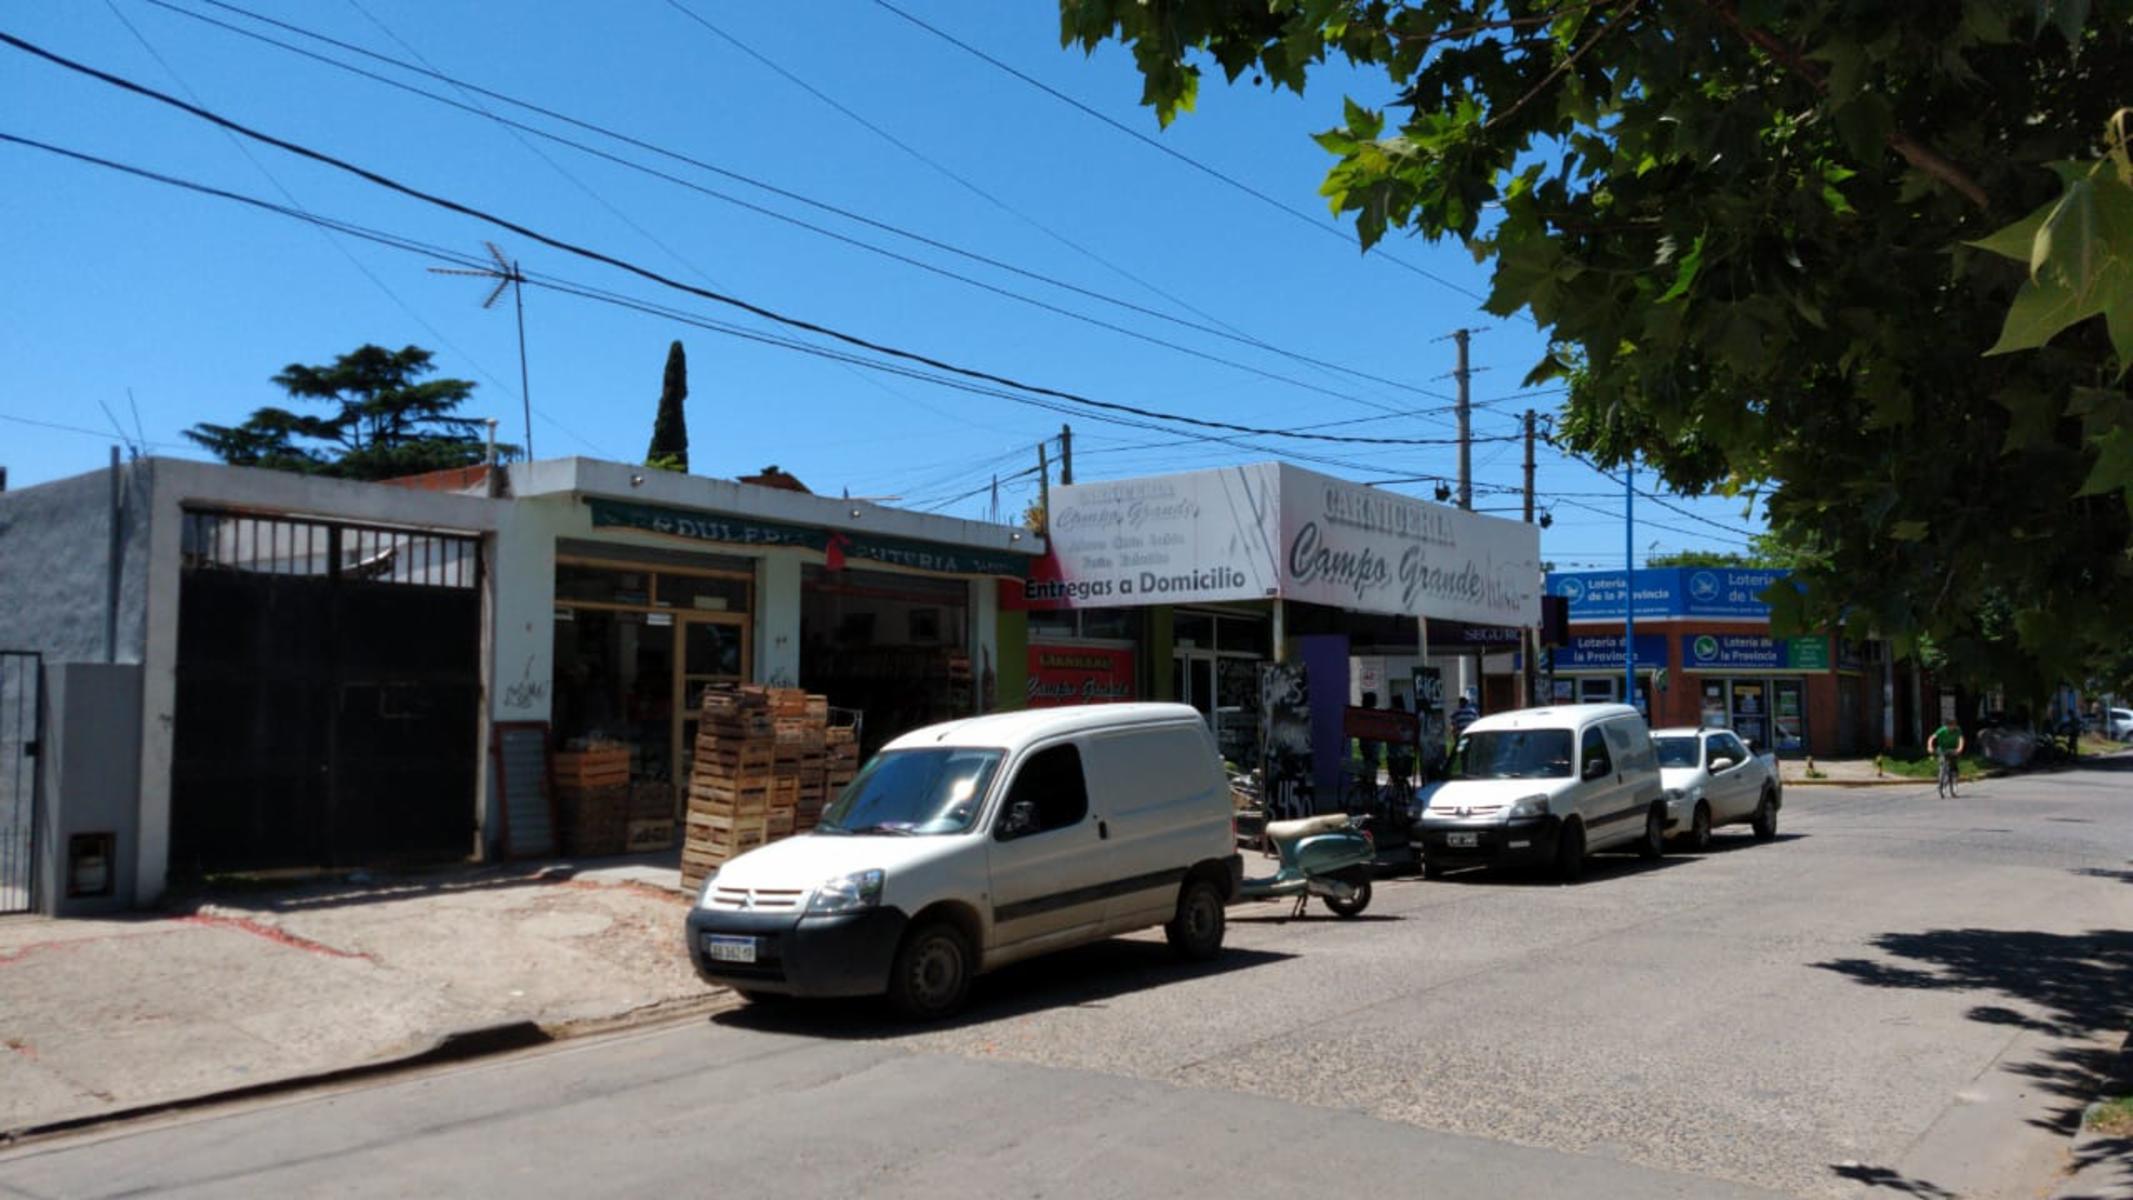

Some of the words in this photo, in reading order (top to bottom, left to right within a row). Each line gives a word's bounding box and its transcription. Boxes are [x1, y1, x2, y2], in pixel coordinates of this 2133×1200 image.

[1289, 521, 1391, 599] Campo
[1398, 544, 1484, 609] Grande
[1024, 576, 1113, 600] Entregas
[1118, 579, 1133, 594] a
[1139, 568, 1247, 594] Domicilio
[1588, 591, 1601, 601] de
[1604, 590, 1615, 600] la
[1729, 588, 1746, 602] de
[1574, 651, 1584, 662] la
[1721, 651, 1730, 661] la
[1732, 650, 1777, 661] Provincia
